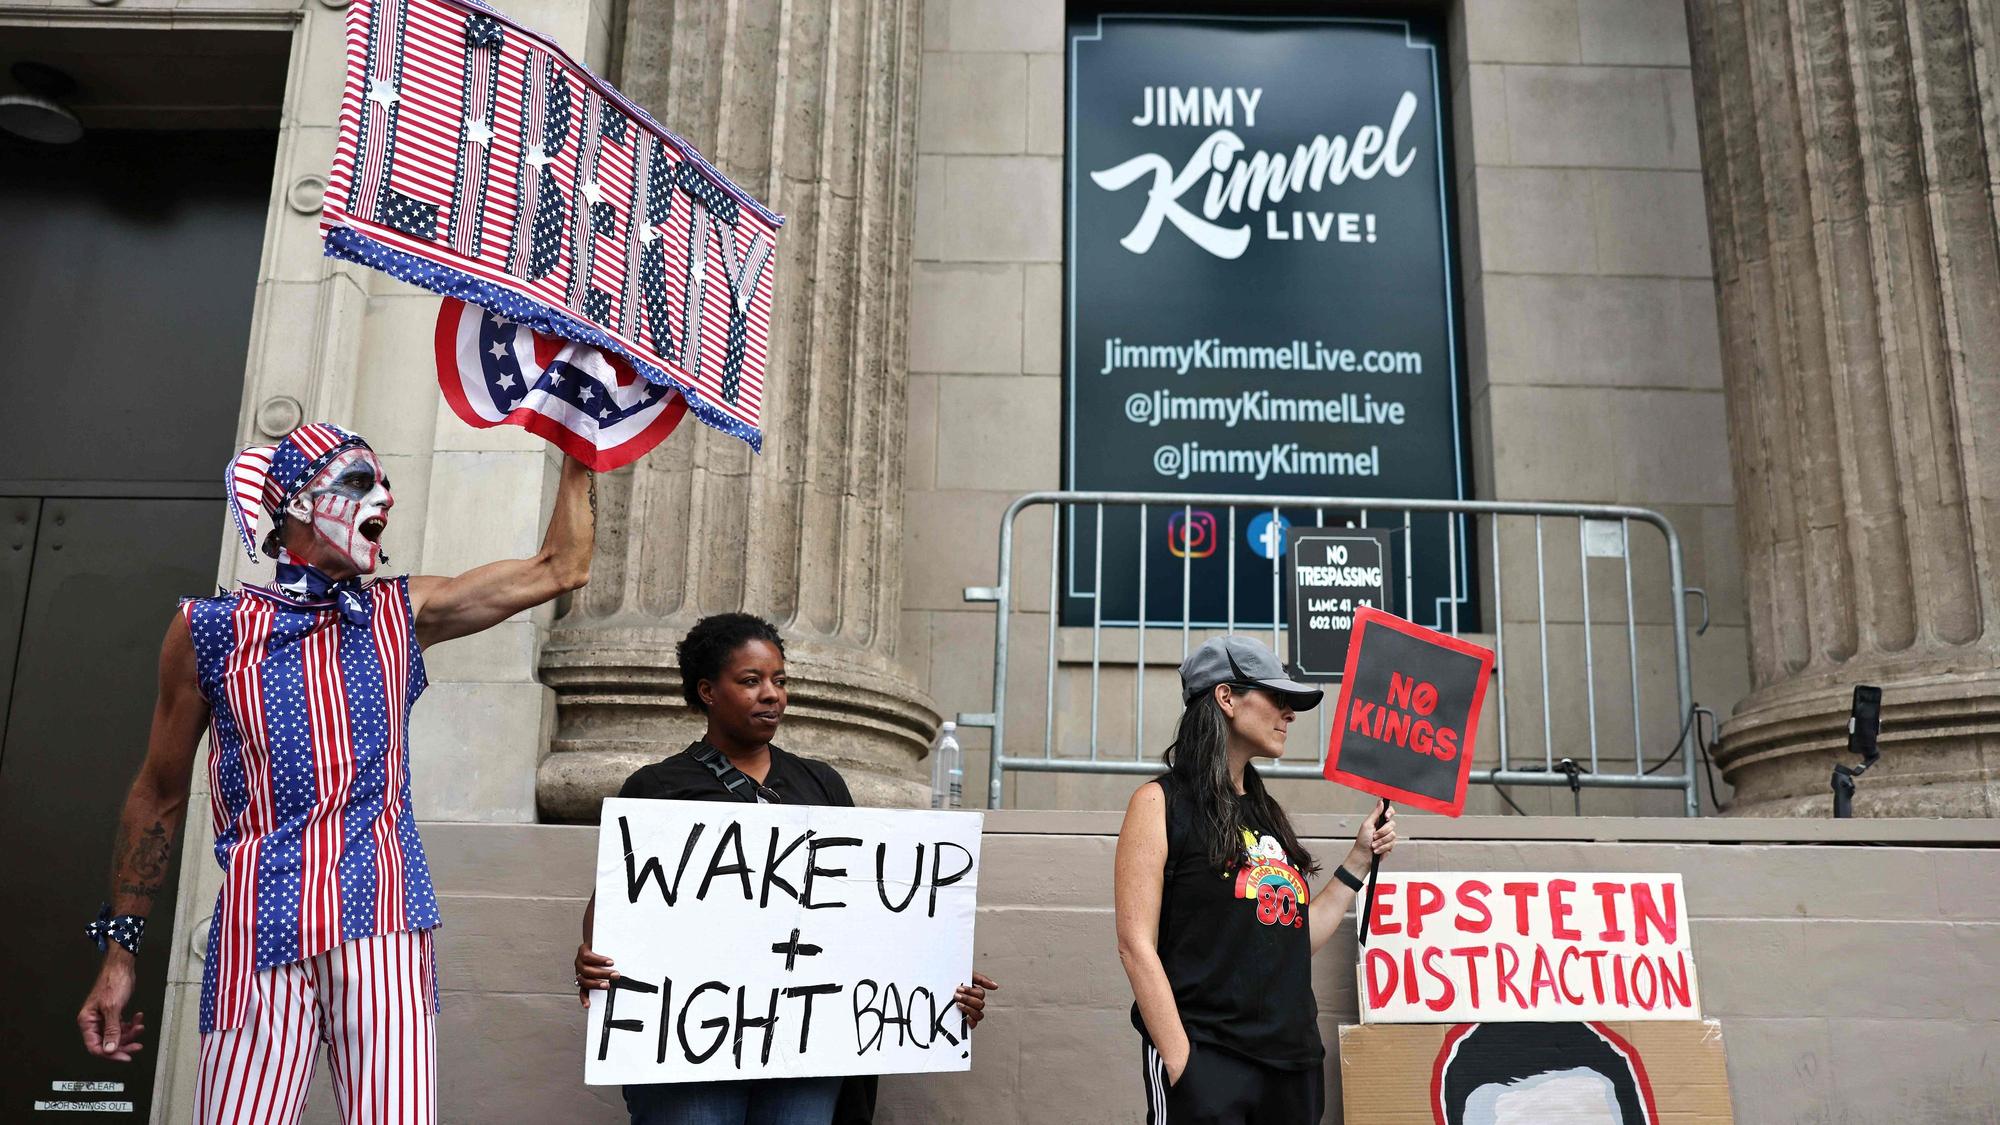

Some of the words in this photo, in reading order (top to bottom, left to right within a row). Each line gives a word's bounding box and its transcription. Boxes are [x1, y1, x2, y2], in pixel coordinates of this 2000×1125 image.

[1132, 86, 1263, 127] JIMMY
[1090, 91, 1418, 260] Kimmel
[346, 0, 772, 406] LIBERTY
[1266, 211, 1378, 244] LIVE!
[1101, 337, 1422, 375] JimmyKimmelLive.com
[1125, 389, 1406, 427] @JimmyKimmelLive
[1153, 442, 1380, 480] @JimmyKimmel
[1326, 545, 1348, 565] NO
[1297, 565, 1382, 587] TRESPASSING
[1308, 598, 1337, 612] LAMC
[1309, 616, 1329, 629] 602
[1332, 615, 1351, 630] (10)
[1349, 698, 1459, 761] KINGS
[618, 816, 863, 909] WAKE
[876, 842, 973, 917] UP
[1247, 867, 1272, 888] Made
[1272, 867, 1285, 877] in
[1287, 873, 1303, 895] the
[1256, 883, 1303, 928] 80's
[1366, 879, 1677, 945] EPSTEIN
[1366, 943, 1692, 1011] DISTRACTION
[598, 976, 843, 1069] FIGHT
[853, 979, 969, 1059] BACK!
[61, 1082, 84, 1091] KEEP
[86, 1082, 115, 1091] CLEAR
